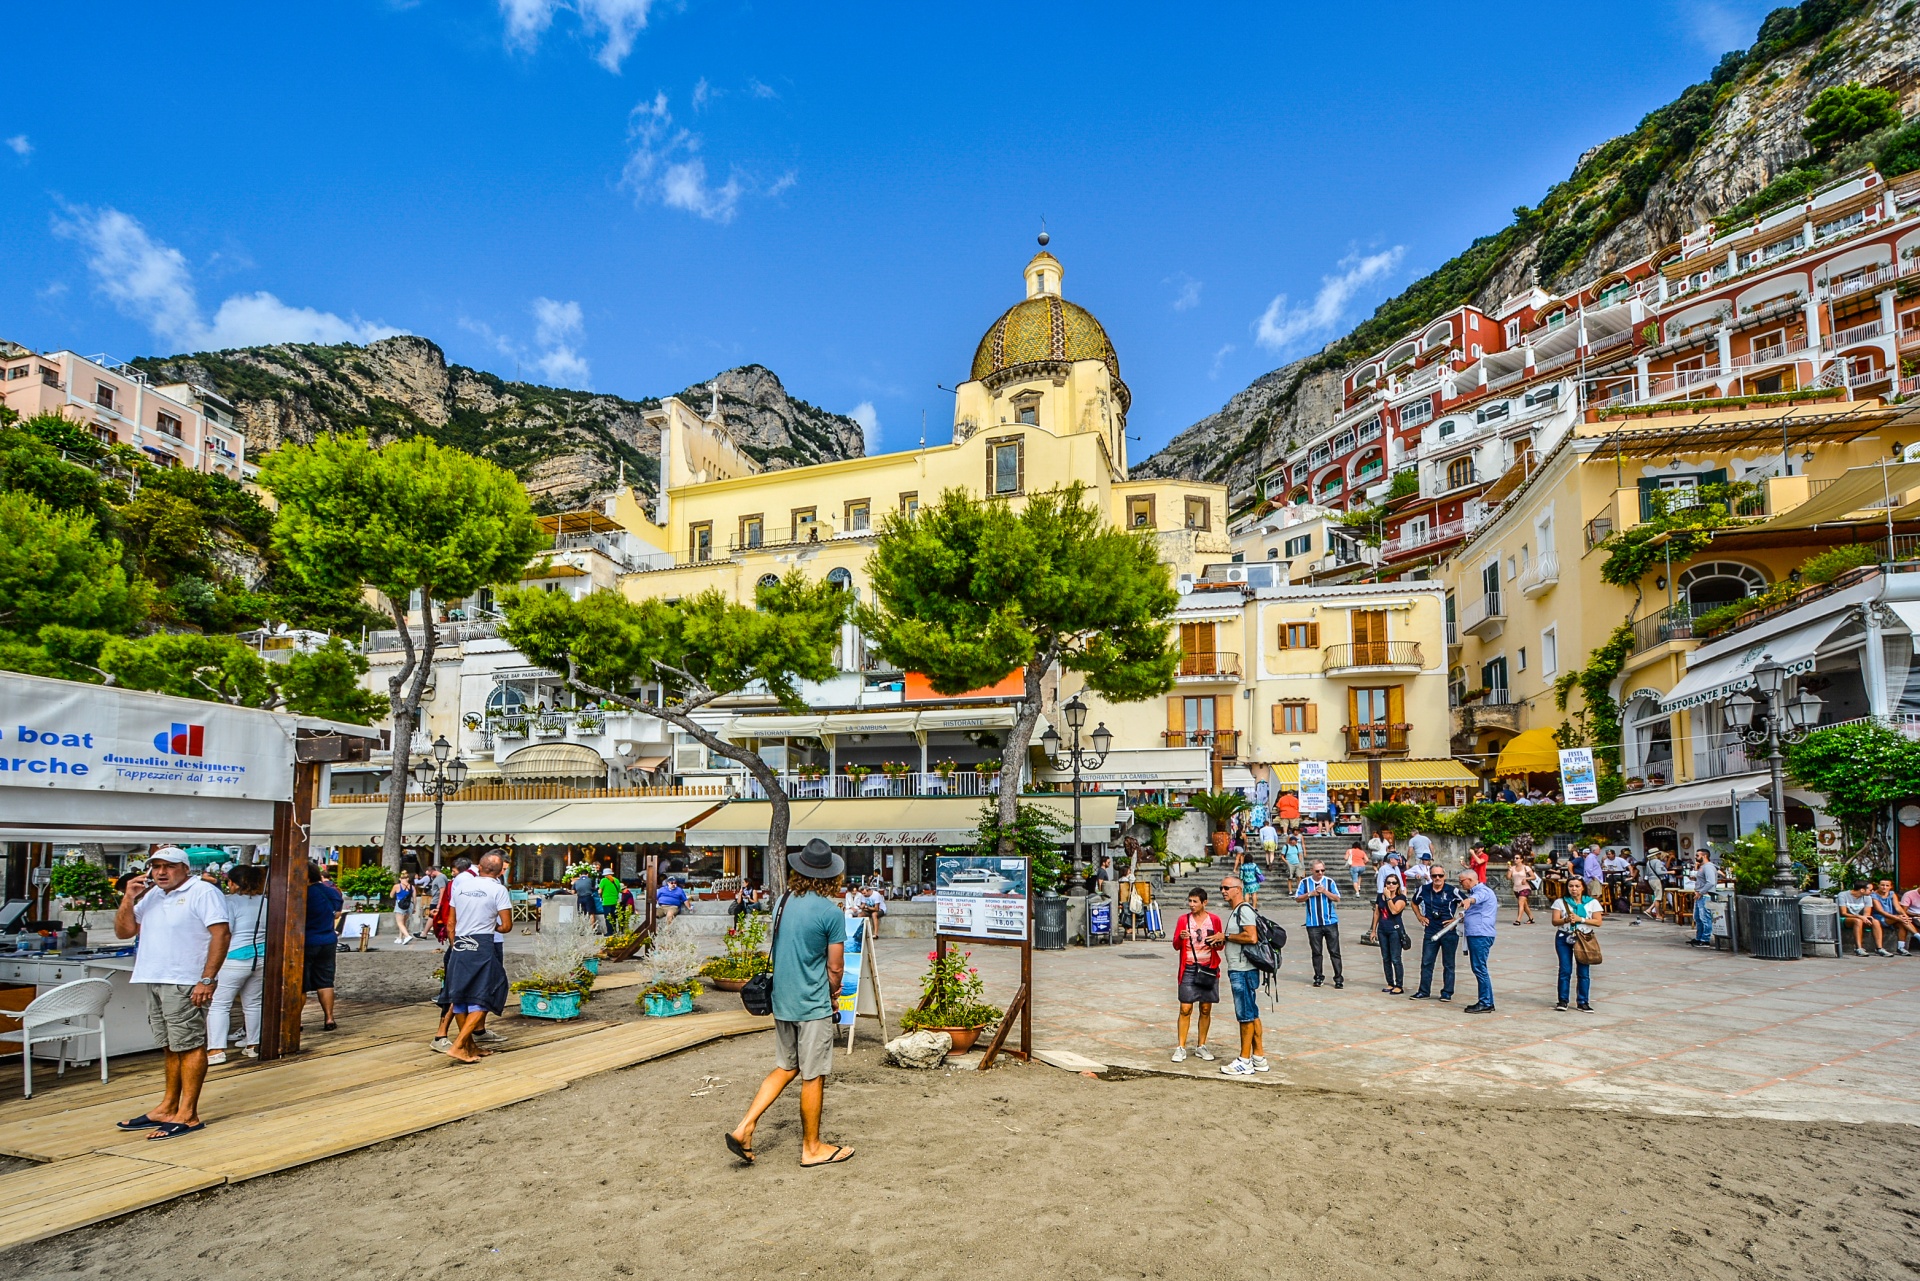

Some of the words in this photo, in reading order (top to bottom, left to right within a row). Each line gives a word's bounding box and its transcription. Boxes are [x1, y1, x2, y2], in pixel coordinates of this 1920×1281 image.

[1786, 659, 1813, 674] CCO
[1662, 689, 1718, 713] RISTORANTE
[1721, 679, 1748, 695] BUCA
[943, 719, 984, 727] RISTORANTE
[18, 725, 94, 749] boat
[103, 753, 169, 767] donadio
[174, 759, 246, 773] designers
[116, 768, 184, 781] Tappezzieri
[187, 773, 203, 783] dal
[207, 775, 240, 785] 1947
[1640, 815, 1664, 831] Cocktail
[1665, 814, 1679, 830] Bar
[370, 834, 426, 845] CEZ
[446, 833, 518, 844] BLACK
[853, 831, 871, 844] Le
[873, 831, 894, 844] Tre
[895, 831, 939, 844] Sorelle
